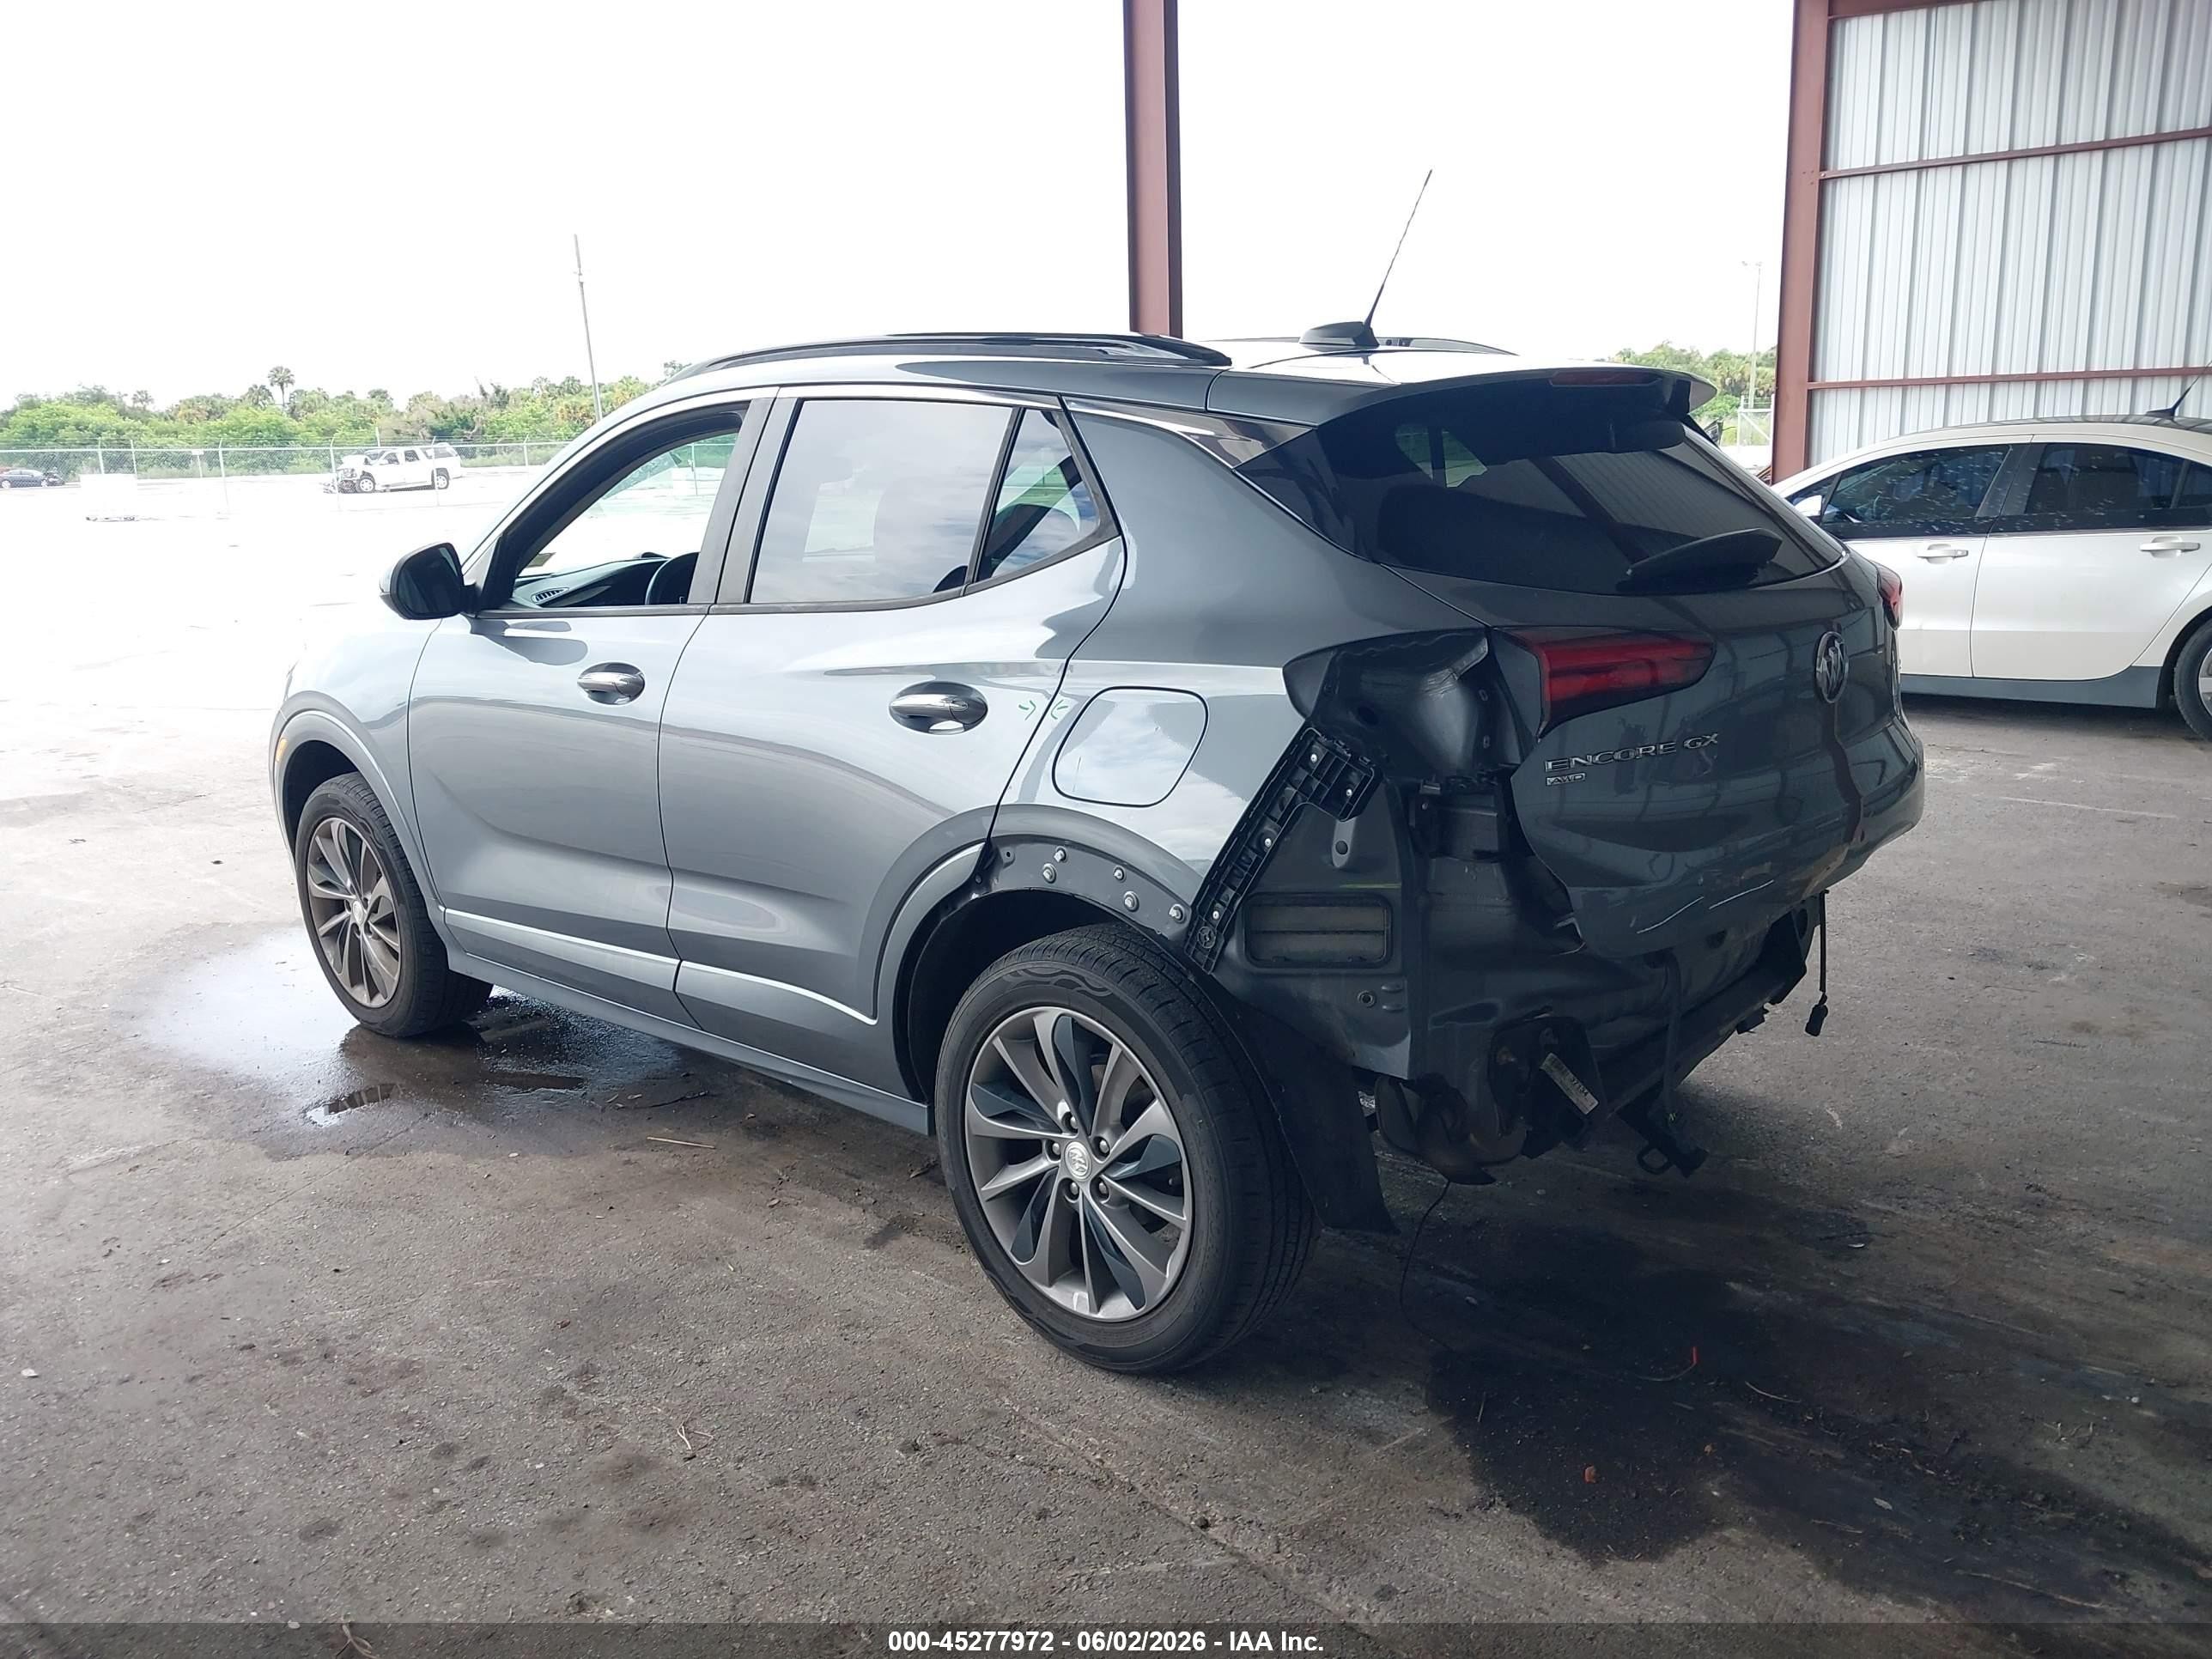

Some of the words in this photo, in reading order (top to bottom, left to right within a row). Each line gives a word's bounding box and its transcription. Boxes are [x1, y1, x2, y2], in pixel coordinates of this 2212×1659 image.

[1545, 741, 1678, 773] ENCORE
[1683, 732, 1719, 750] GX
[1546, 772, 1587, 787] AWD
